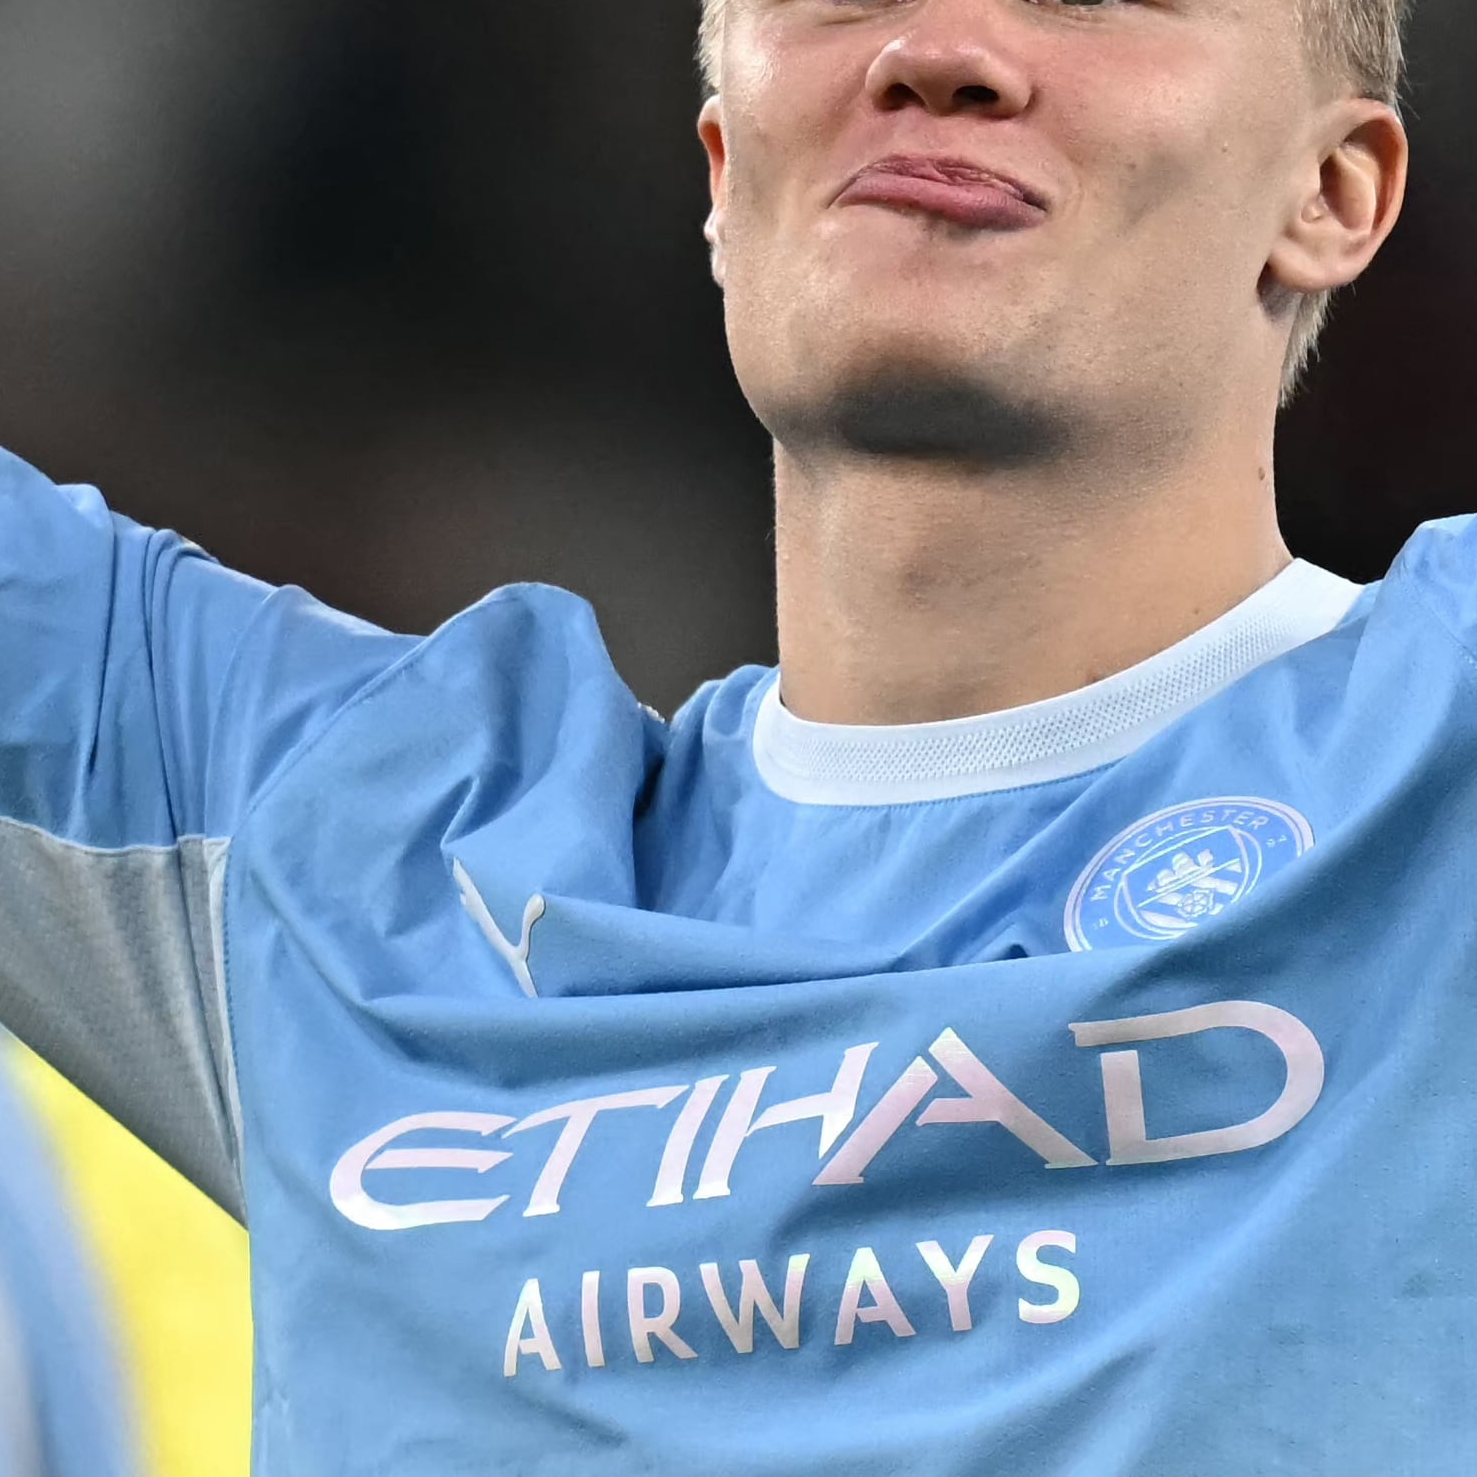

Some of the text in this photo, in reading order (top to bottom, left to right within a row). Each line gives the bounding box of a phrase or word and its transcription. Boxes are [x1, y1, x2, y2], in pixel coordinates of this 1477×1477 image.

[1090, 809, 1269, 902] MANCHESTER
[328, 1000, 1325, 1231] ETIHAD
[503, 1229, 1080, 1377] AIRWAYS
